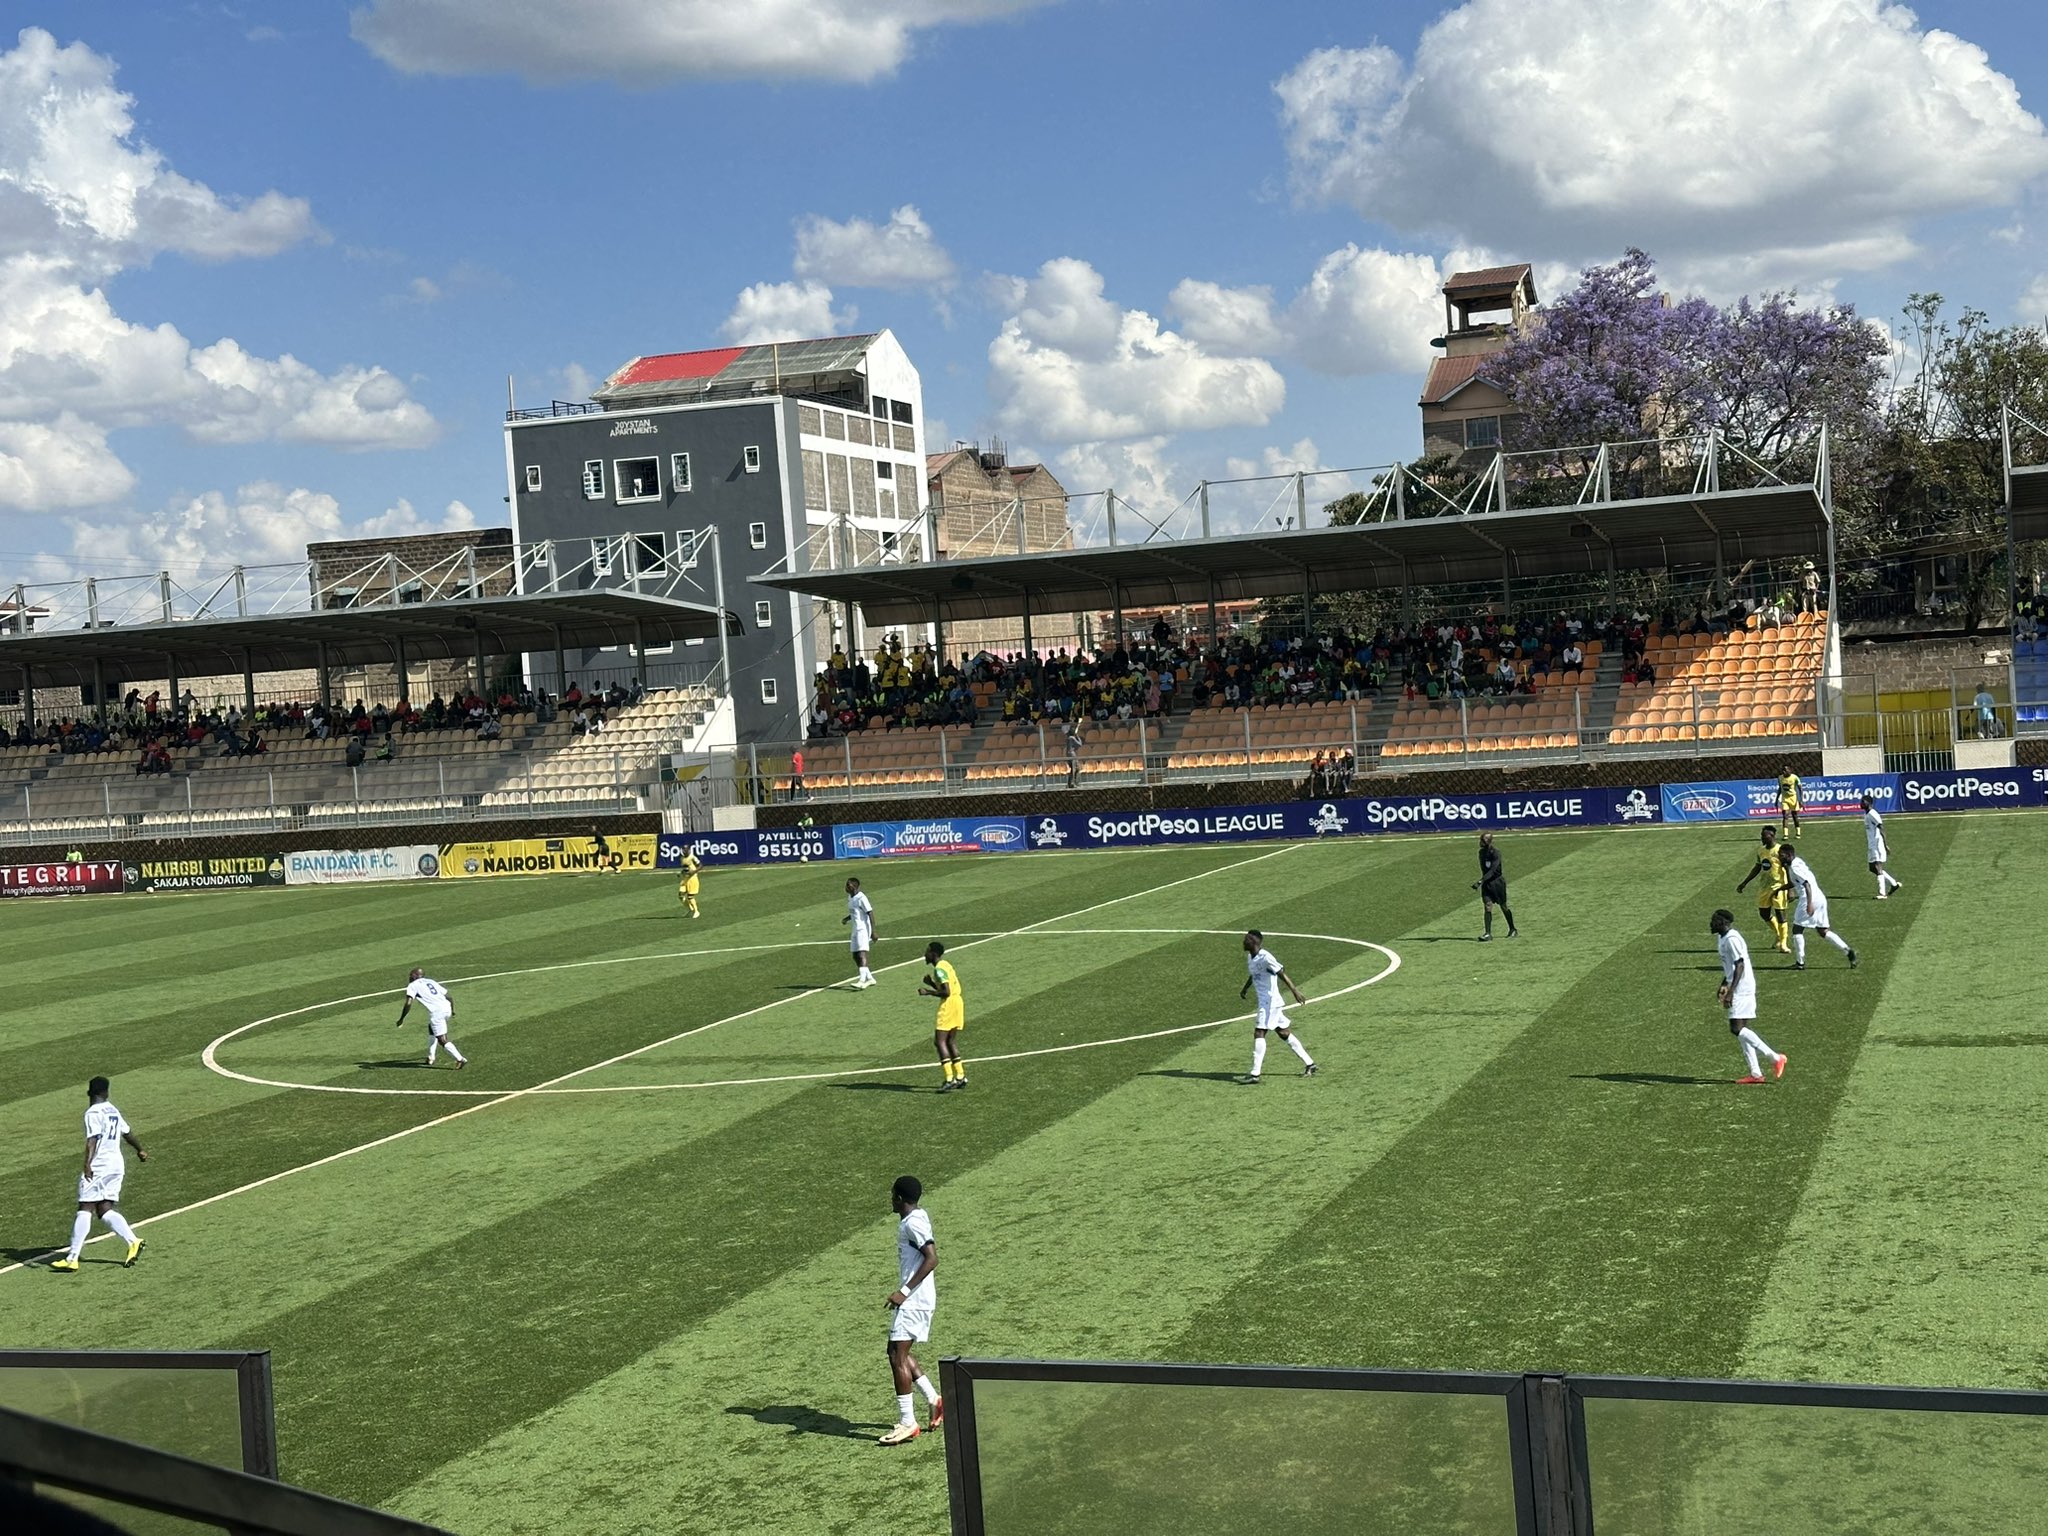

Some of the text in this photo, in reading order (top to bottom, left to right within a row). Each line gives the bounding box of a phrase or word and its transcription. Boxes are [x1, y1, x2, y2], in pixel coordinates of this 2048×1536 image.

[609, 425, 659, 437] APARTMENTS
[615, 419, 651, 429] JOYSTAN
[1836, 787, 1863, 801] 844
[1905, 778, 2020, 804] SportPesa
[1366, 798, 1583, 828] SportPesa LEAGUE
[758, 831, 823, 841] PAYBILL NO:
[905, 821, 952, 834] Burudani
[1088, 813, 1284, 843] SportPesa LEAGUE
[895, 830, 963, 846] Kwa wote
[660, 839, 739, 861] SprtPesa
[758, 842, 823, 857] 955100
[141, 857, 266, 878] NAIROBI UNITED
[292, 853, 398, 871] BANDARI F.C.
[483, 850, 650, 872] NAIROBI UNITD FC
[1, 863, 117, 885] TEGRITY
[154, 874, 253, 888] SAKAJA FOUNDATION
